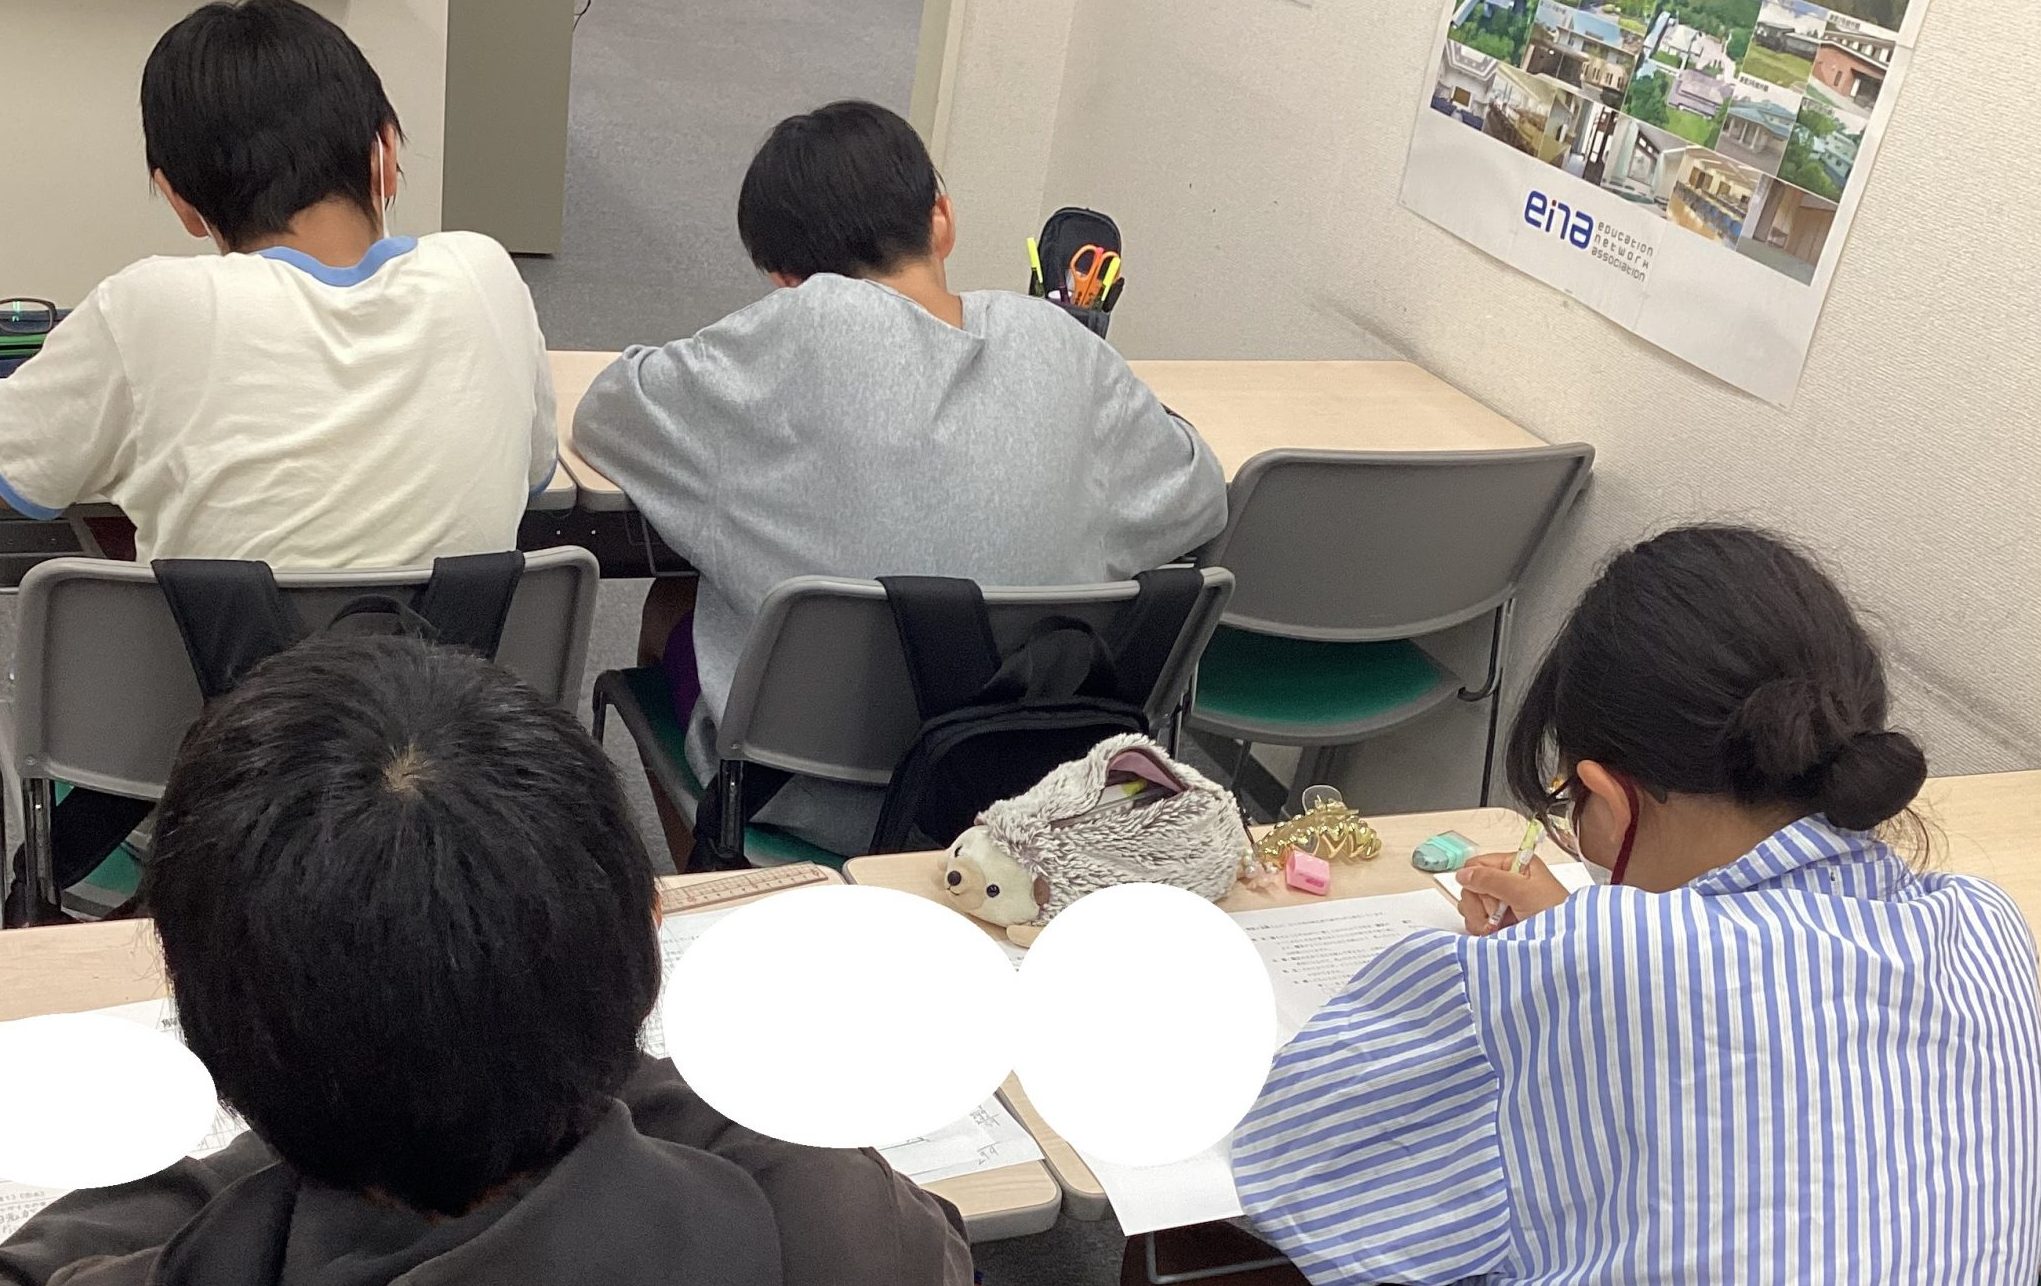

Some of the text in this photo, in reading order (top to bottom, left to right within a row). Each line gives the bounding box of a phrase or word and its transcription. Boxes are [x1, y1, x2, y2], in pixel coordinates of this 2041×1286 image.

[1594, 233, 1649, 269] network
[1598, 221, 1654, 257] education
[1591, 246, 1646, 281] association
